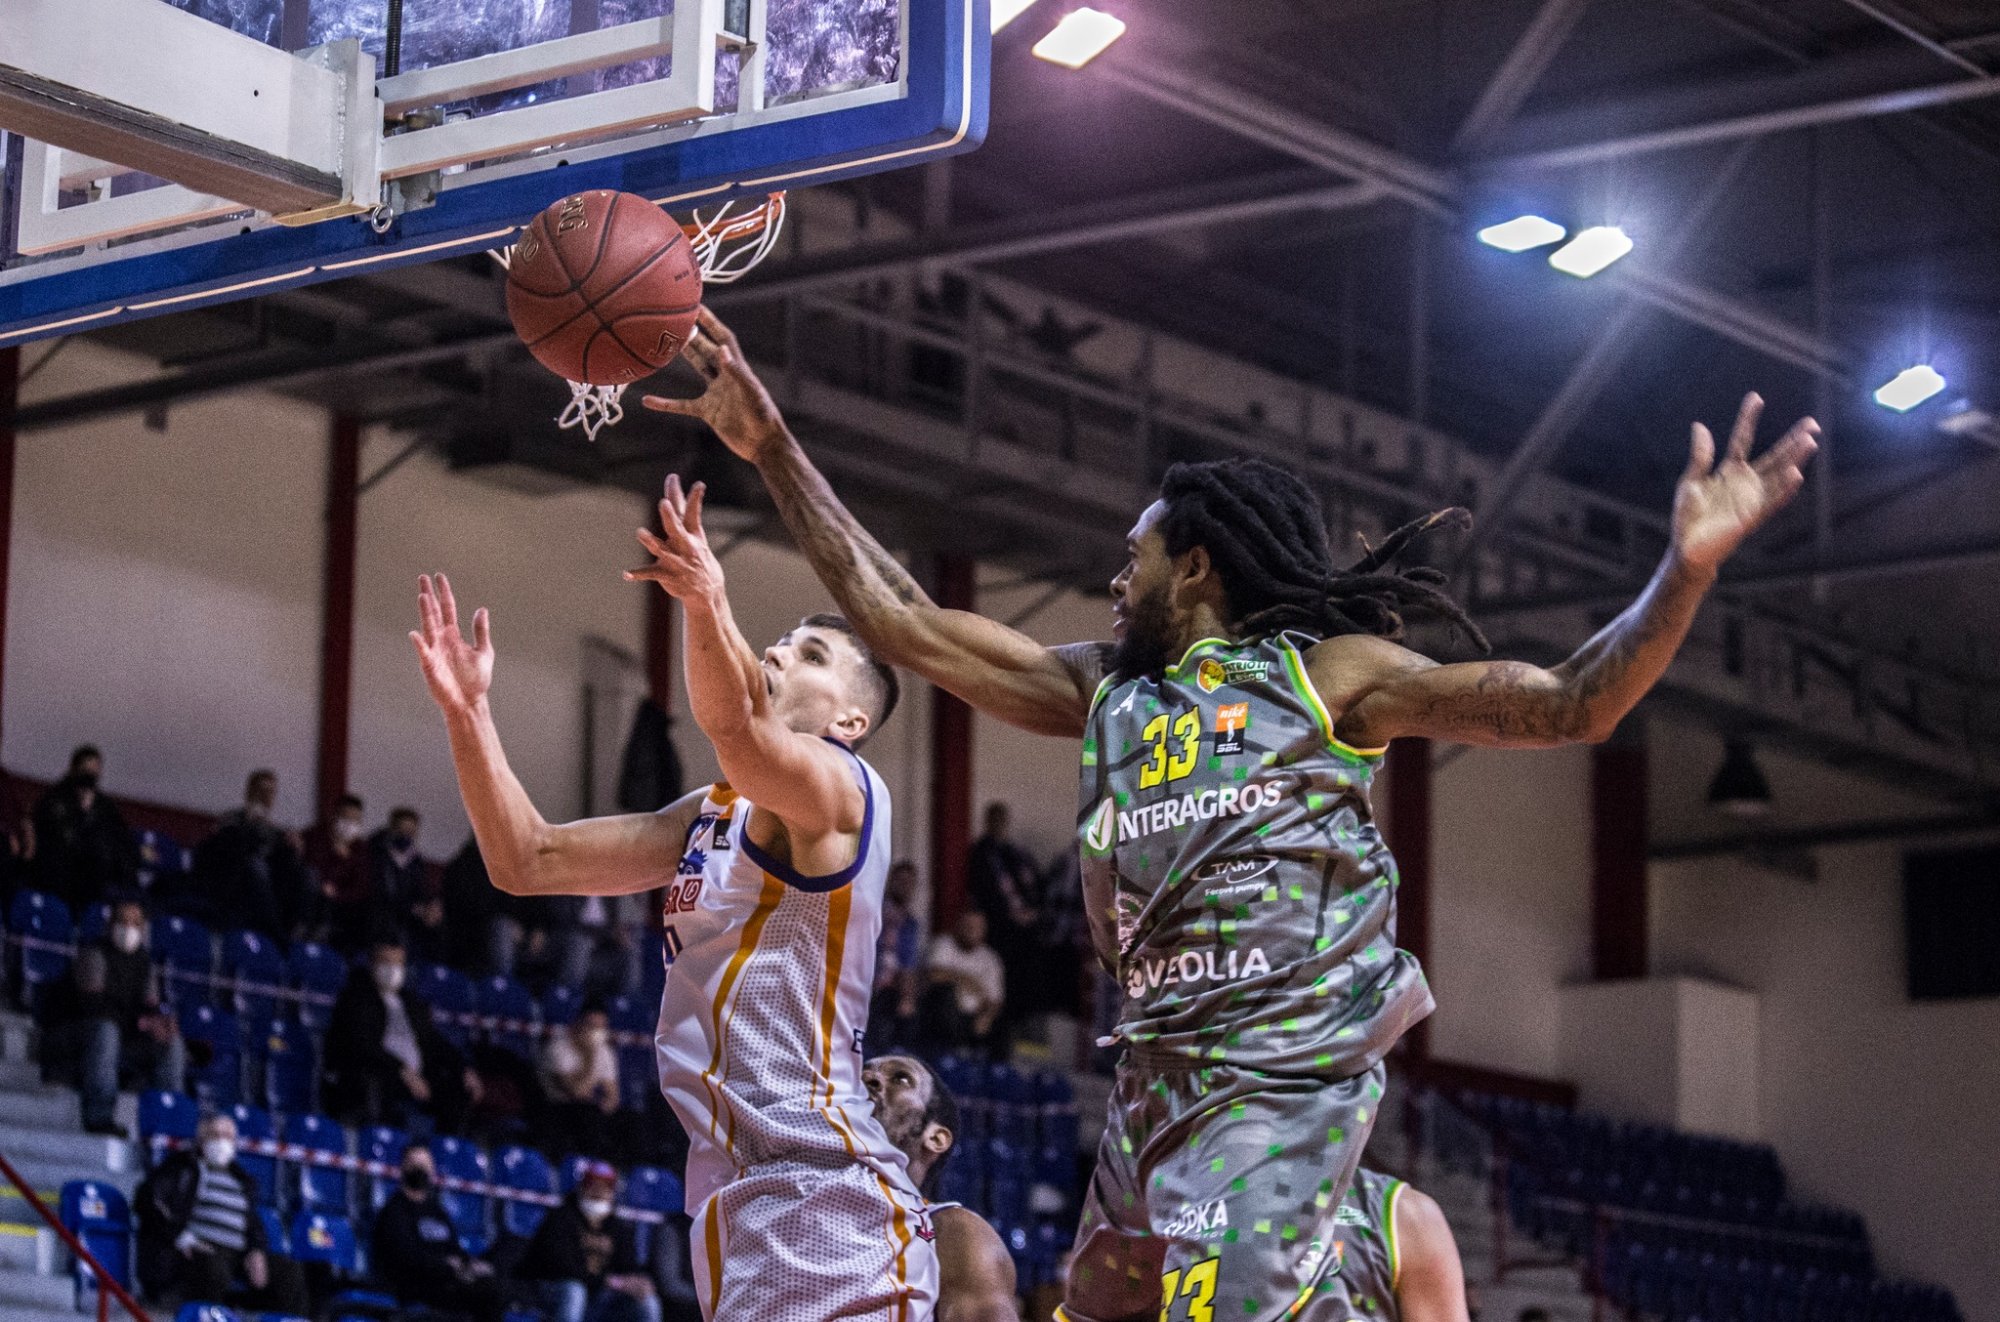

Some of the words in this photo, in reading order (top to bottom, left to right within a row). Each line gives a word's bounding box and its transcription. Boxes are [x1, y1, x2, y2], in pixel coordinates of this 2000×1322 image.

[1139, 705, 1201, 789] 33
[1216, 743, 1241, 753] SBL
[1146, 947, 1271, 988] VEOLIA
